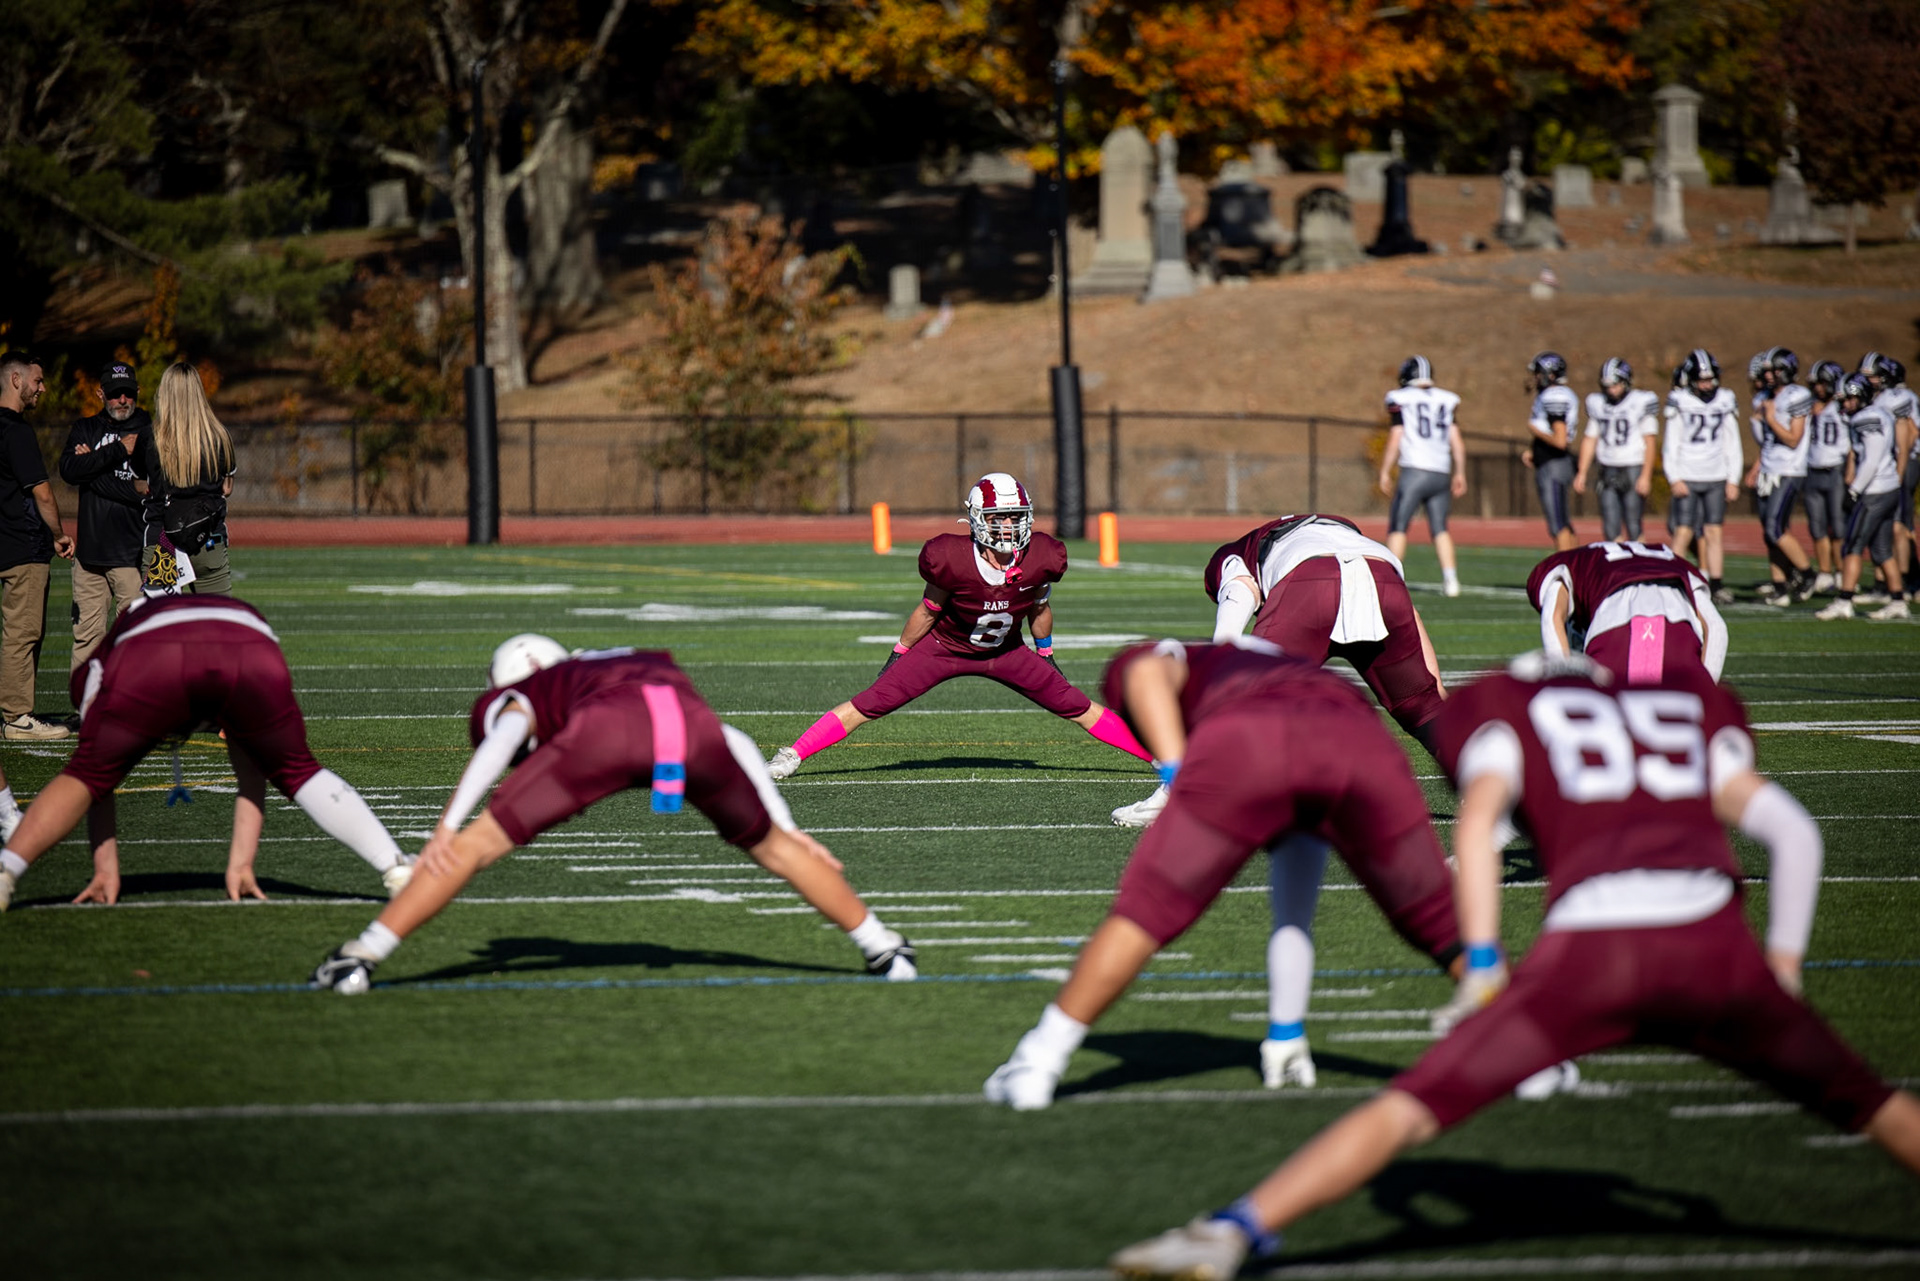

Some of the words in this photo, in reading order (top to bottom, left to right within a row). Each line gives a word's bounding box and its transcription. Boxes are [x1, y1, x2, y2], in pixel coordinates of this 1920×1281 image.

[1416, 402, 1447, 441] 64
[1689, 411, 1723, 443] 27
[983, 600, 1010, 611] RAMS
[969, 612, 1014, 648] 8
[1528, 686, 1707, 802] 85
